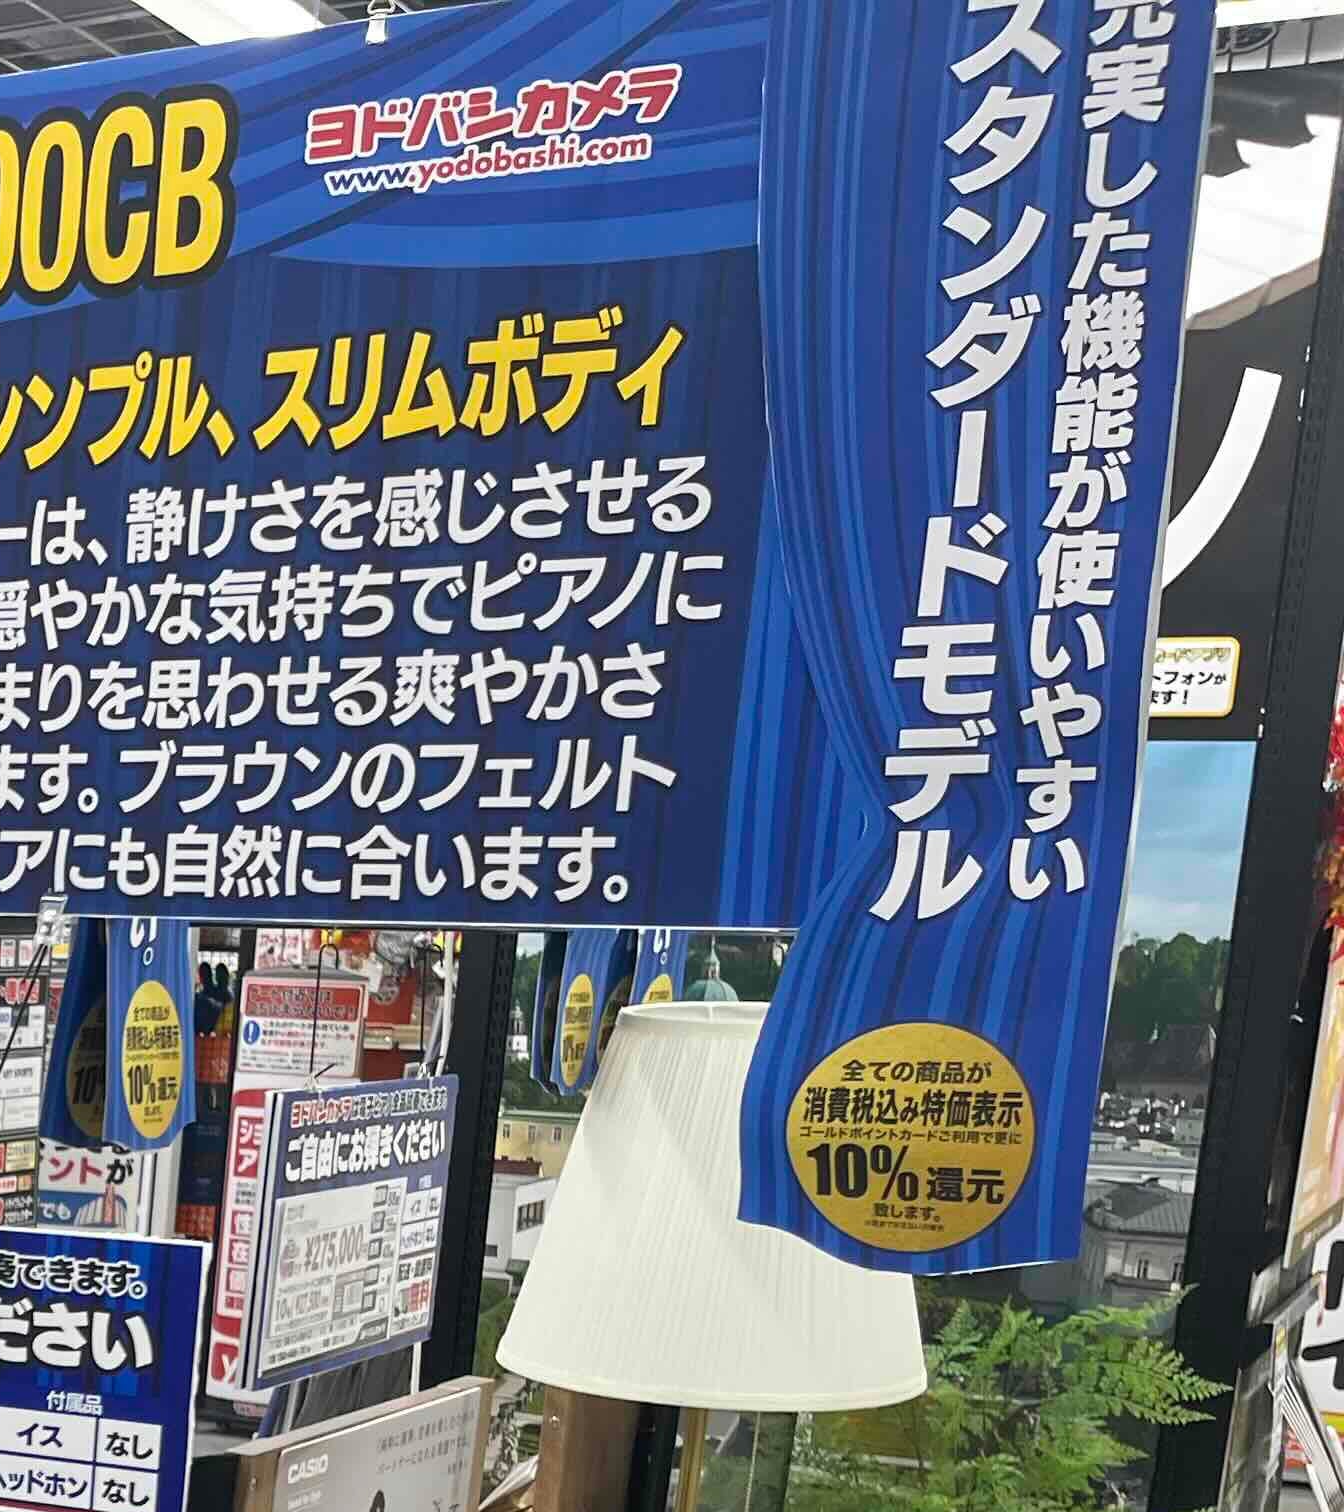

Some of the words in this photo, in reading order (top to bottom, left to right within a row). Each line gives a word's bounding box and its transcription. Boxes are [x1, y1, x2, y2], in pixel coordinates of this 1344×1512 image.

[306, 64, 683, 167] ヨドバシカメラ
[325, 134, 653, 197] www.yodobashi.com
[868, 0, 1063, 921] スタンダードモデル
[841, 1060, 992, 1085] 全ての商品が
[802, 1087, 1025, 1128] 消費税込み特価表示
[799, 1125, 1023, 1146] ゴールドポイントカードご利用で更に
[806, 1145, 920, 1203] 10%
[926, 1165, 1006, 1205] 還元
[40, 1202, 72, 1220] でも
[872, 1202, 942, 1222] 致します。
[46, 1389, 104, 1415] 付属品
[16, 1423, 64, 1448] イス
[104, 1431, 153, 1460] なし
[287, 1453, 329, 1485] CASIO
[101, 1478, 150, 1506] なし
